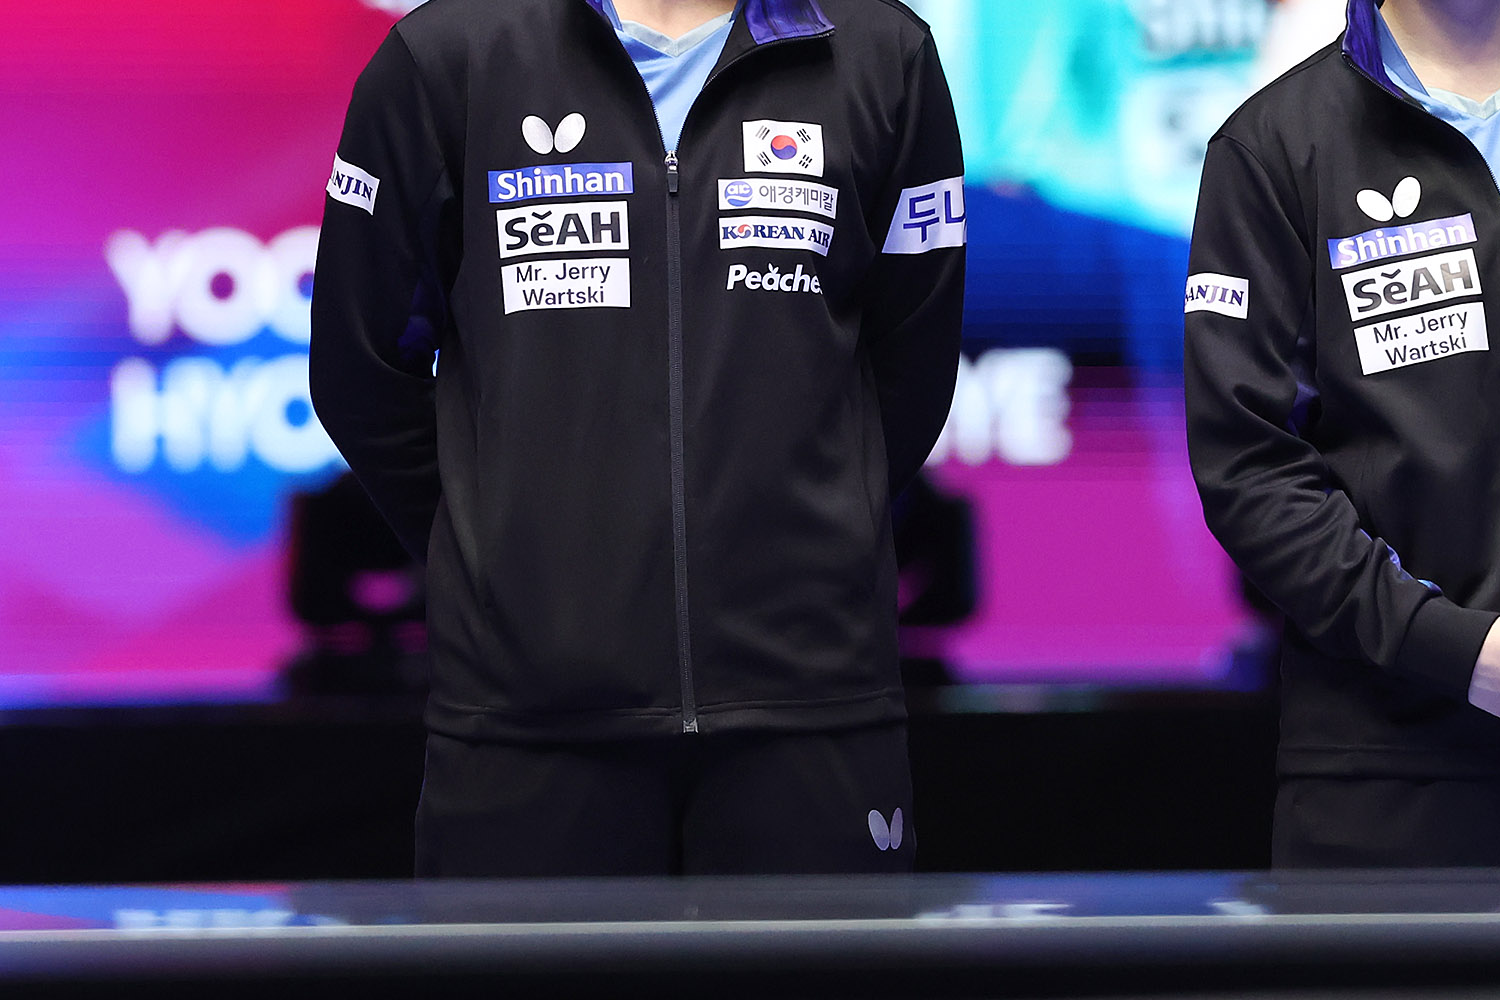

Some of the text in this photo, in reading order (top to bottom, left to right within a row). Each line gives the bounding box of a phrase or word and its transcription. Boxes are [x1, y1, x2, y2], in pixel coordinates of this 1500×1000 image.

[332, 168, 373, 202] NJIN
[497, 167, 624, 201] Shinhan
[759, 185, 834, 212] 애경케미칼
[722, 224, 830, 248] KOREAN AIR
[1337, 222, 1467, 266] Shinhan
[516, 262, 611, 284] Mr. Jerry
[726, 263, 823, 295] Peache
[522, 286, 605, 306] Wartski
[1373, 311, 1468, 344] Mr. Jerry
[1385, 332, 1467, 366] Wartski
